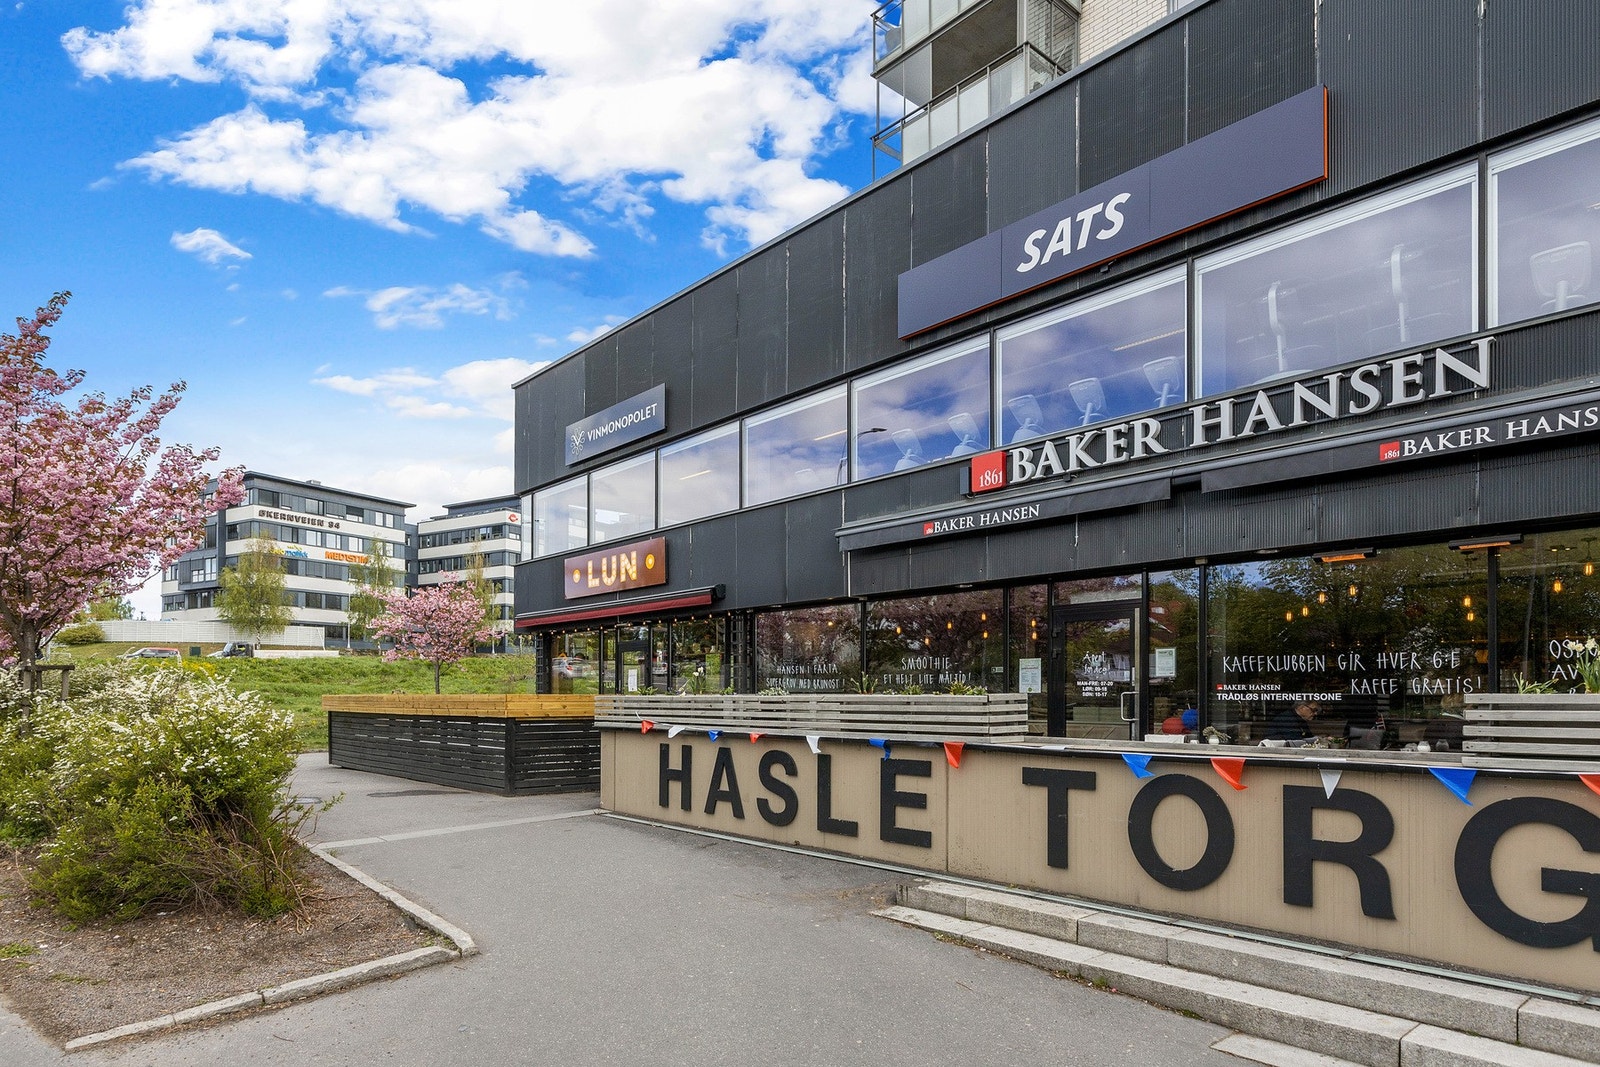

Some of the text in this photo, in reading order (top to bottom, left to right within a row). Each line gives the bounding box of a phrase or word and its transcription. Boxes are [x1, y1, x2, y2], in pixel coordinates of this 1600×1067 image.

[1016, 192, 1132, 273] SATS
[587, 403, 658, 442] VINMONOPOLET
[979, 336, 1498, 488] 1861 BAKER HANSEN
[1384, 406, 1600, 459] 1861 BAKER HANS
[258, 509, 325, 527] ØKERNVEIEN
[934, 515, 975, 533] BAKER
[980, 504, 1040, 526] HANSEN
[587, 551, 638, 588] LUN
[1223, 654, 1326, 673] KAFFEKLUBBEN
[1376, 652, 1421, 670] HVER
[1216, 692, 1342, 701] TRÅDLØS INTERNETTSONE
[1351, 678, 1398, 695] KAFFE
[658, 743, 1600, 952] HASLE TORG
